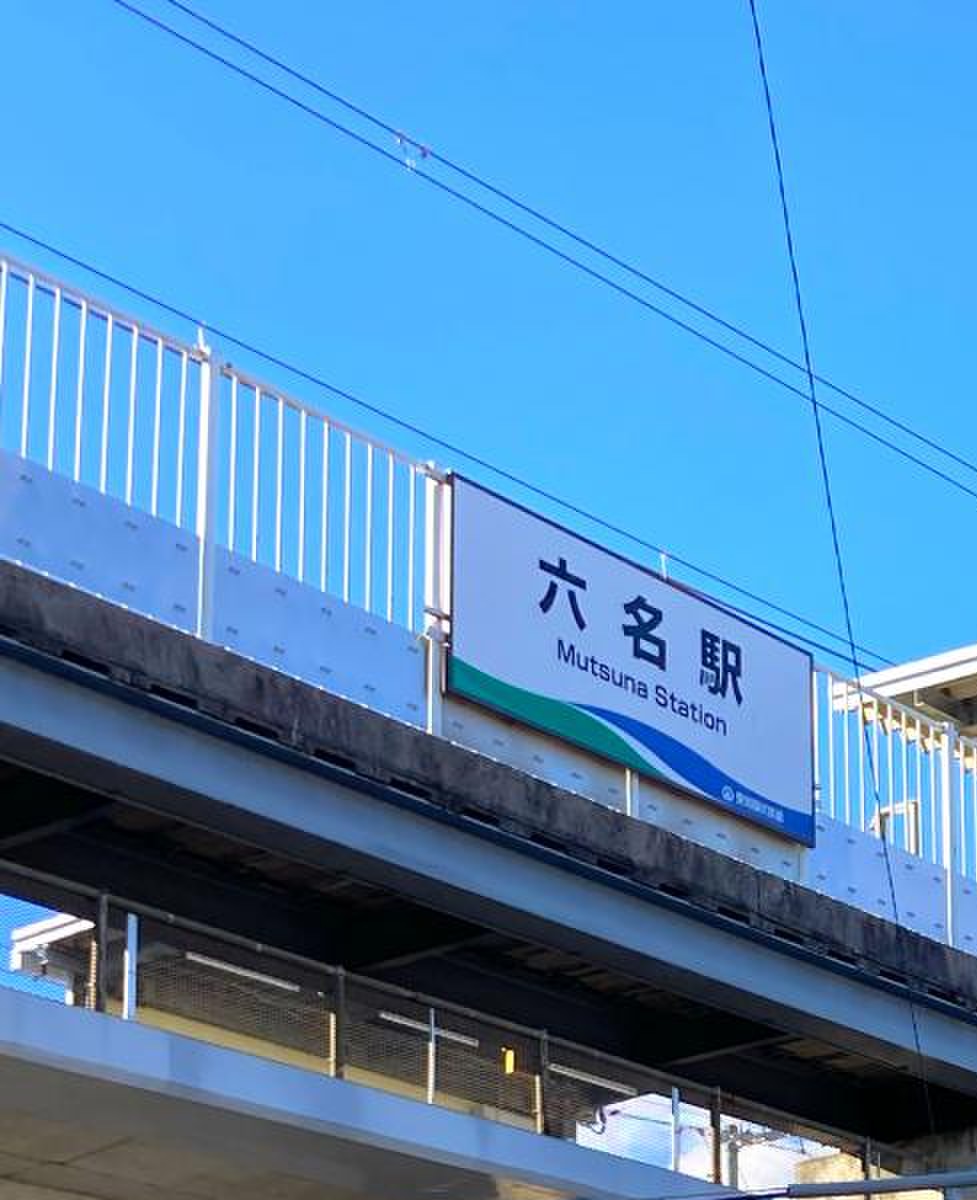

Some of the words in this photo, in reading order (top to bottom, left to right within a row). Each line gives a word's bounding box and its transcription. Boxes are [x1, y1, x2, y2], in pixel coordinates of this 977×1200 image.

[538, 557, 743, 705] 六名駅
[557, 639, 649, 699] Mutsuna
[655, 685, 728, 736] Station
